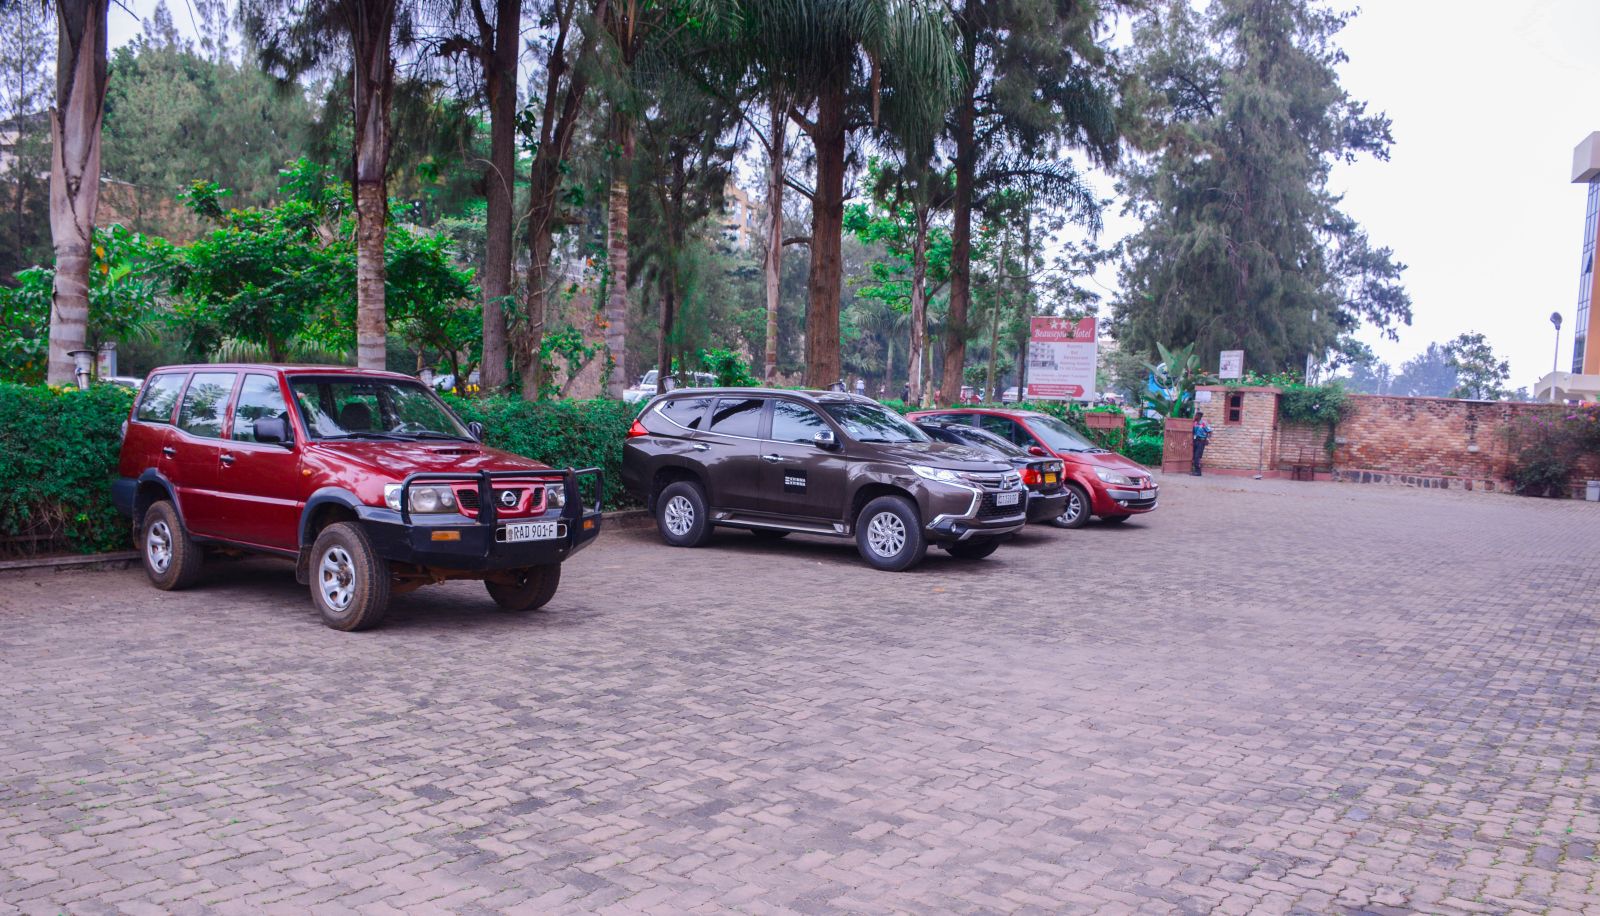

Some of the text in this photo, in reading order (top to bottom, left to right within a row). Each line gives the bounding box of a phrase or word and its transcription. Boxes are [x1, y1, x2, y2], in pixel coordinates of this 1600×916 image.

[1035, 327, 1093, 341] Beausejou Hotel
[513, 525, 530, 540] RAD
